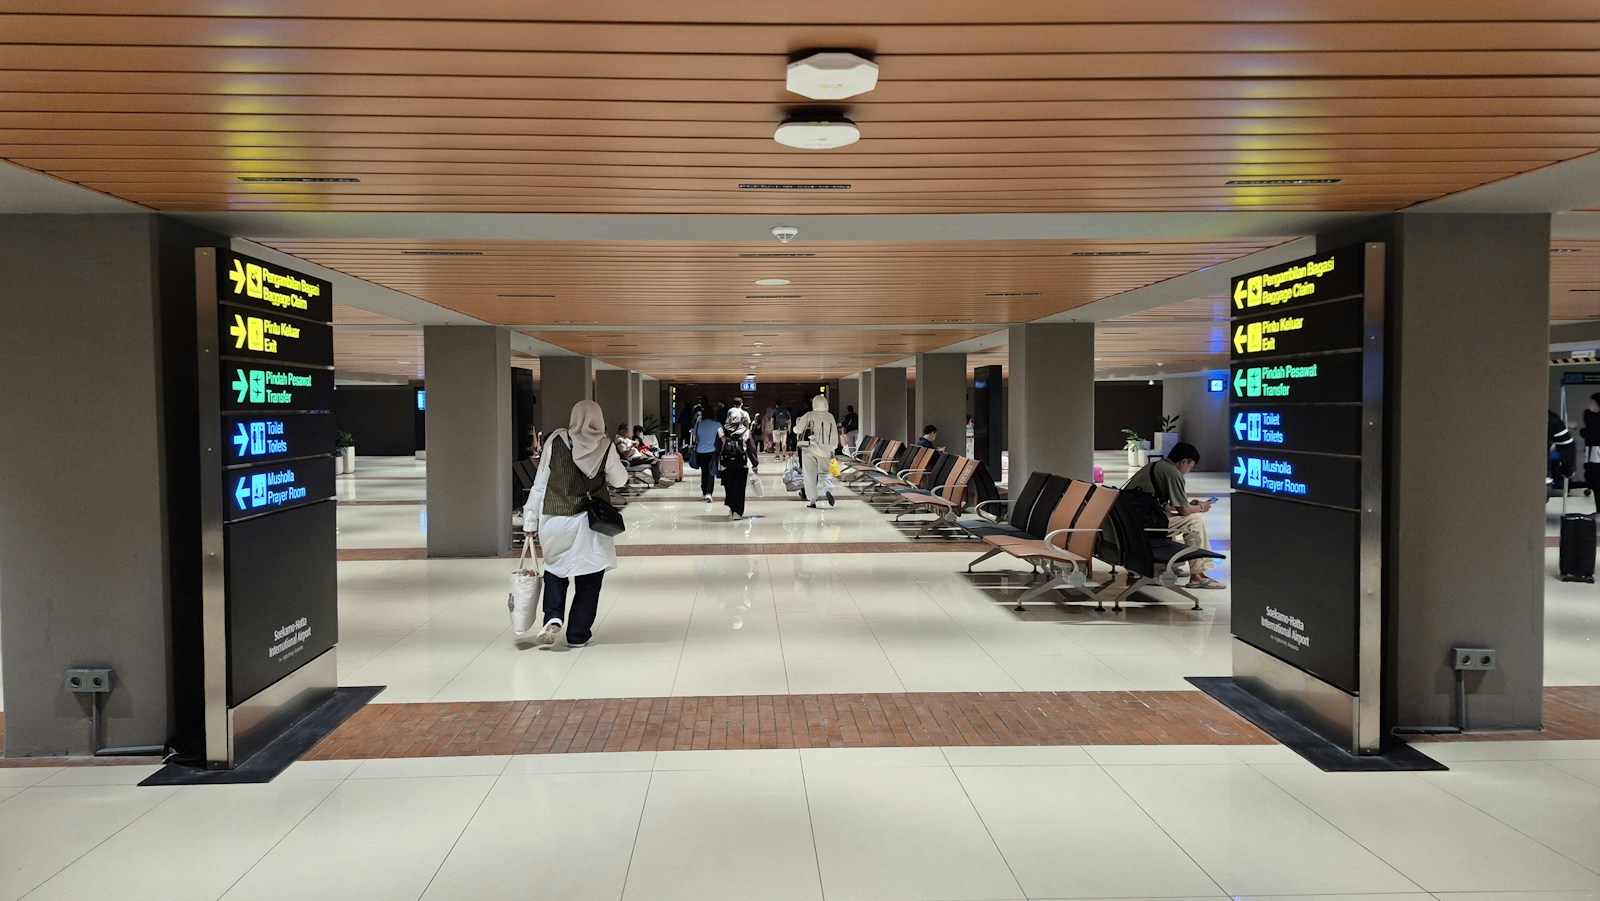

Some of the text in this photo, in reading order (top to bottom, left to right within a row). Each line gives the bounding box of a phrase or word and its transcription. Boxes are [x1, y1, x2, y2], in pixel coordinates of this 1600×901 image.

[1262, 256, 1335, 287] Pengambilan Bagasi
[301, 279, 320, 297] Bagasi
[1262, 281, 1315, 305] Baggage Claim
[262, 286, 308, 310] Baggage Claim
[263, 319, 300, 338] Pintu Keluar
[1262, 317, 1304, 334] Pintu Keluar
[264, 338, 277, 353] Exit
[1262, 337, 1276, 351] Exit
[265, 371, 312, 387] Pindah Pesawat
[1262, 364, 1318, 379] Pindah Pesawat
[265, 389, 292, 403] Transfer
[1262, 383, 1290, 397] Transfer
[266, 421, 284, 434] Toilet
[1262, 413, 1281, 426] Toilet
[1262, 430, 1284, 443] Toilets
[266, 439, 287, 453] Toilets
[1262, 459, 1292, 475] Musholla
[267, 469, 295, 485] Musholla
[1262, 476, 1306, 494] Prayer Room
[268, 486, 306, 505] Prayer Room
[1260, 616, 1291, 638] International
[1291, 630, 1309, 647] Airport
